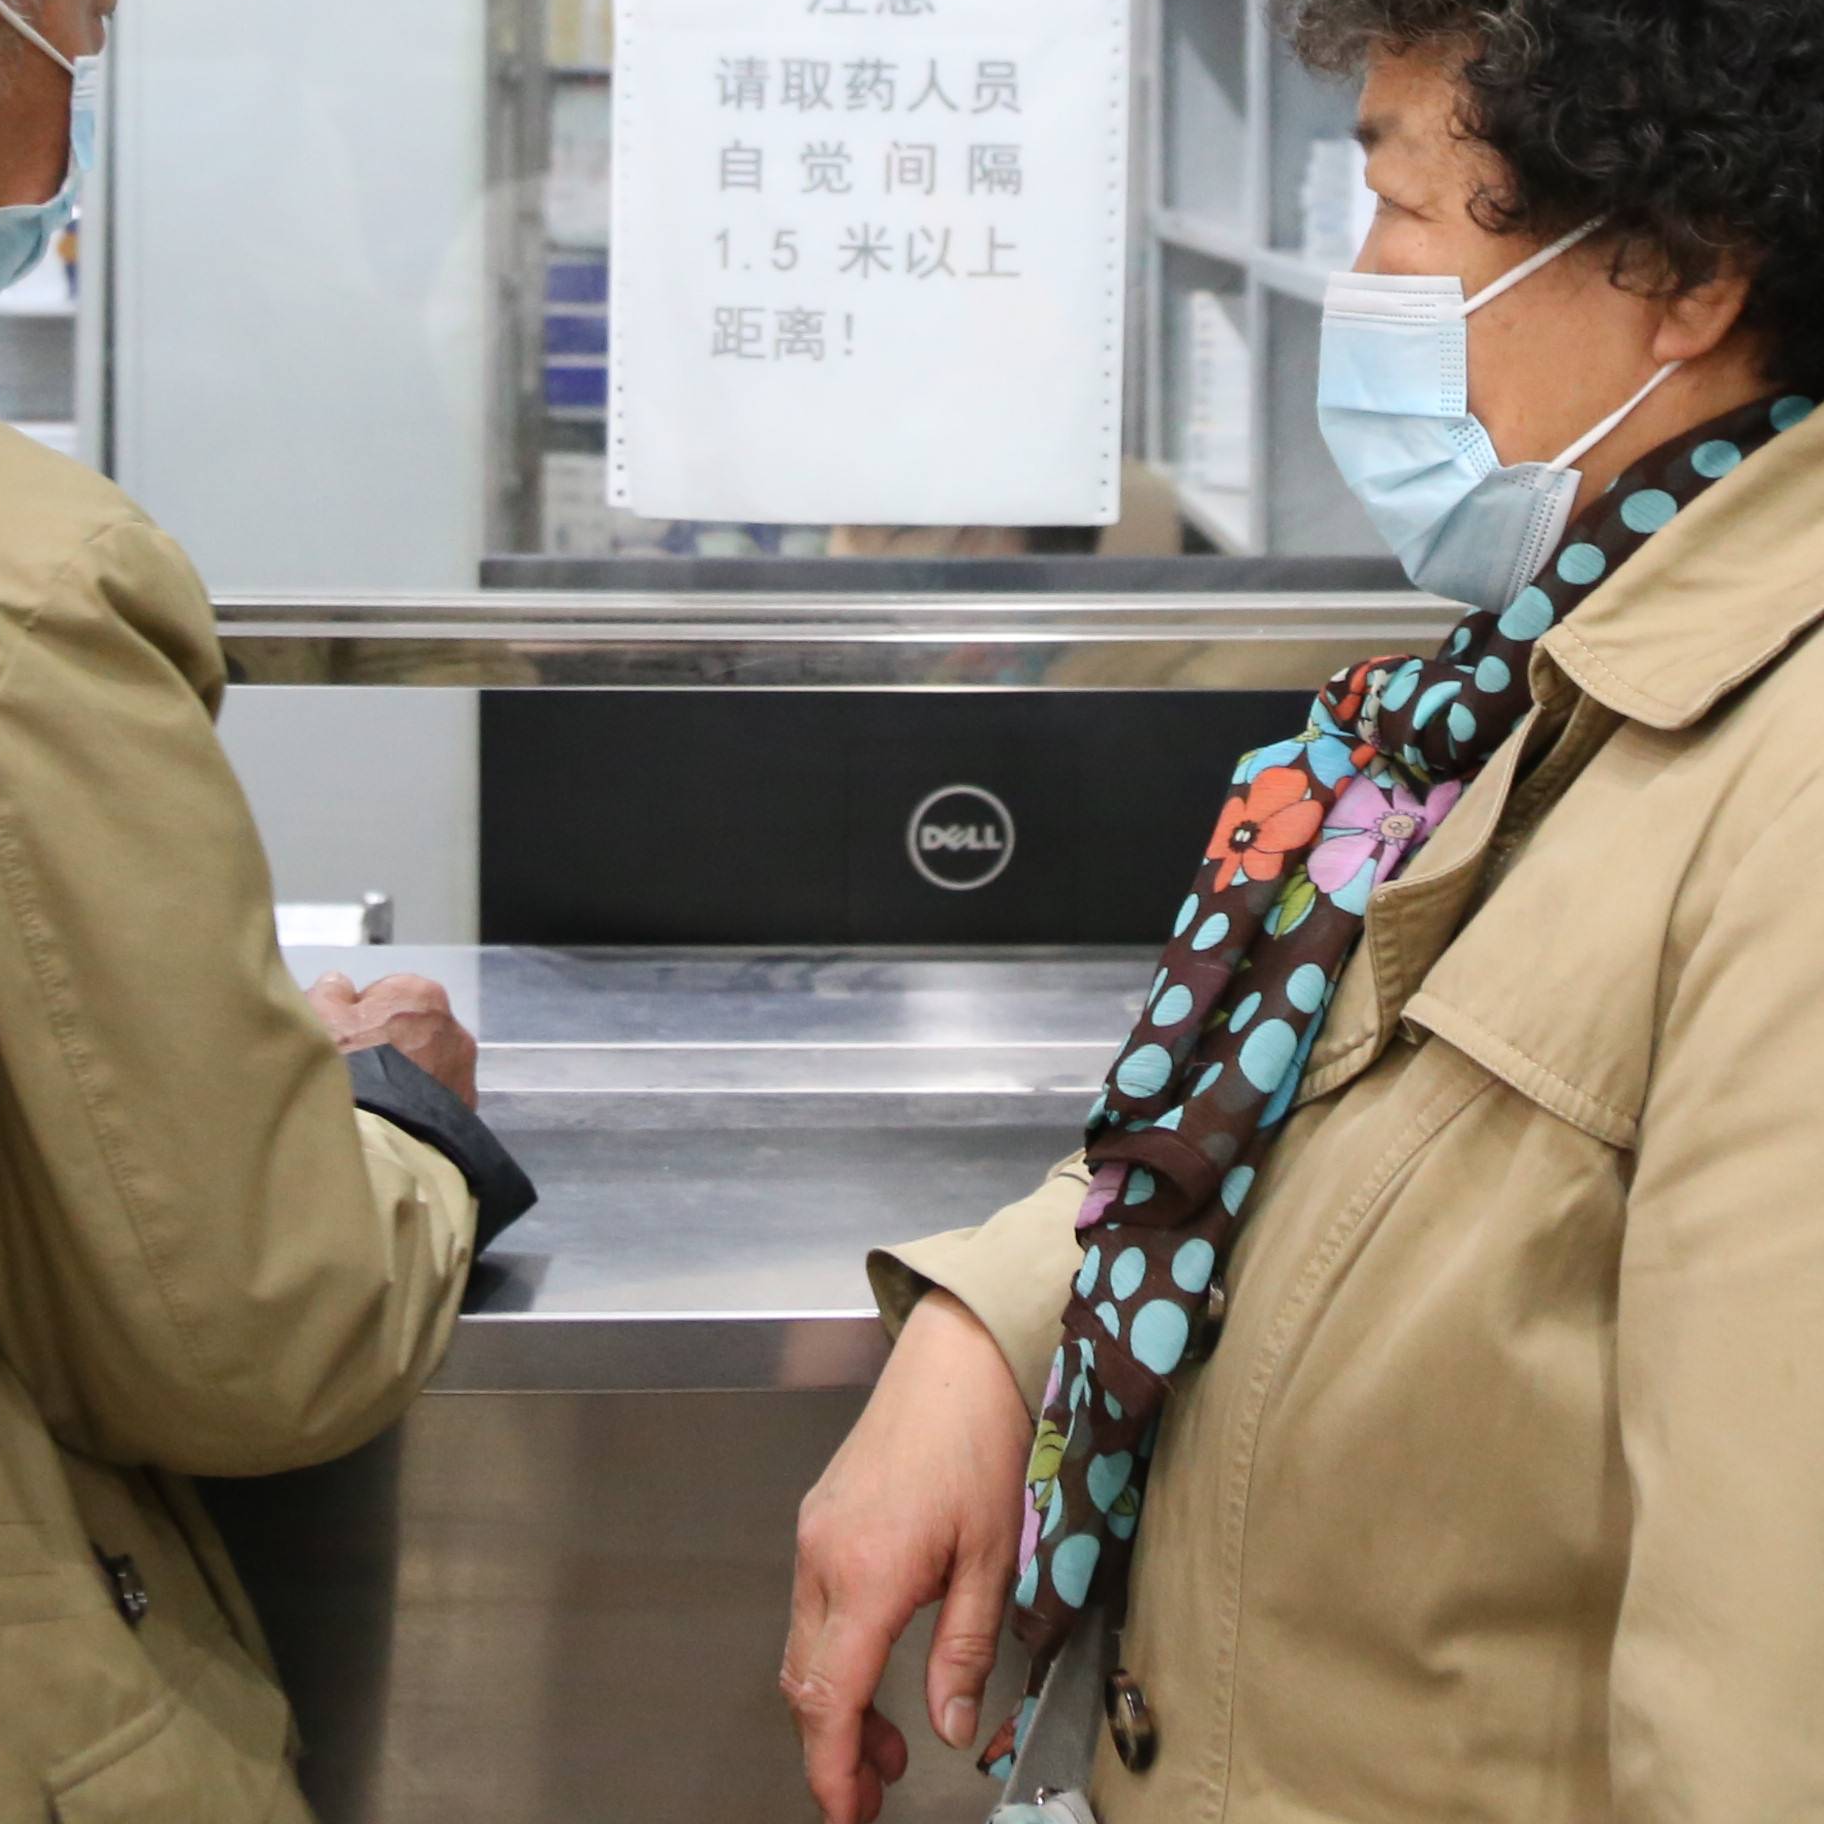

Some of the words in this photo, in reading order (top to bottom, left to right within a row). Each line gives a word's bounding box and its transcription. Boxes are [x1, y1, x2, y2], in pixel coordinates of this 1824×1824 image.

[714, 57, 1023, 114] 请取药人员
[719, 141, 1023, 196] 自觉间隔
[920, 824, 1002, 850] DELL
